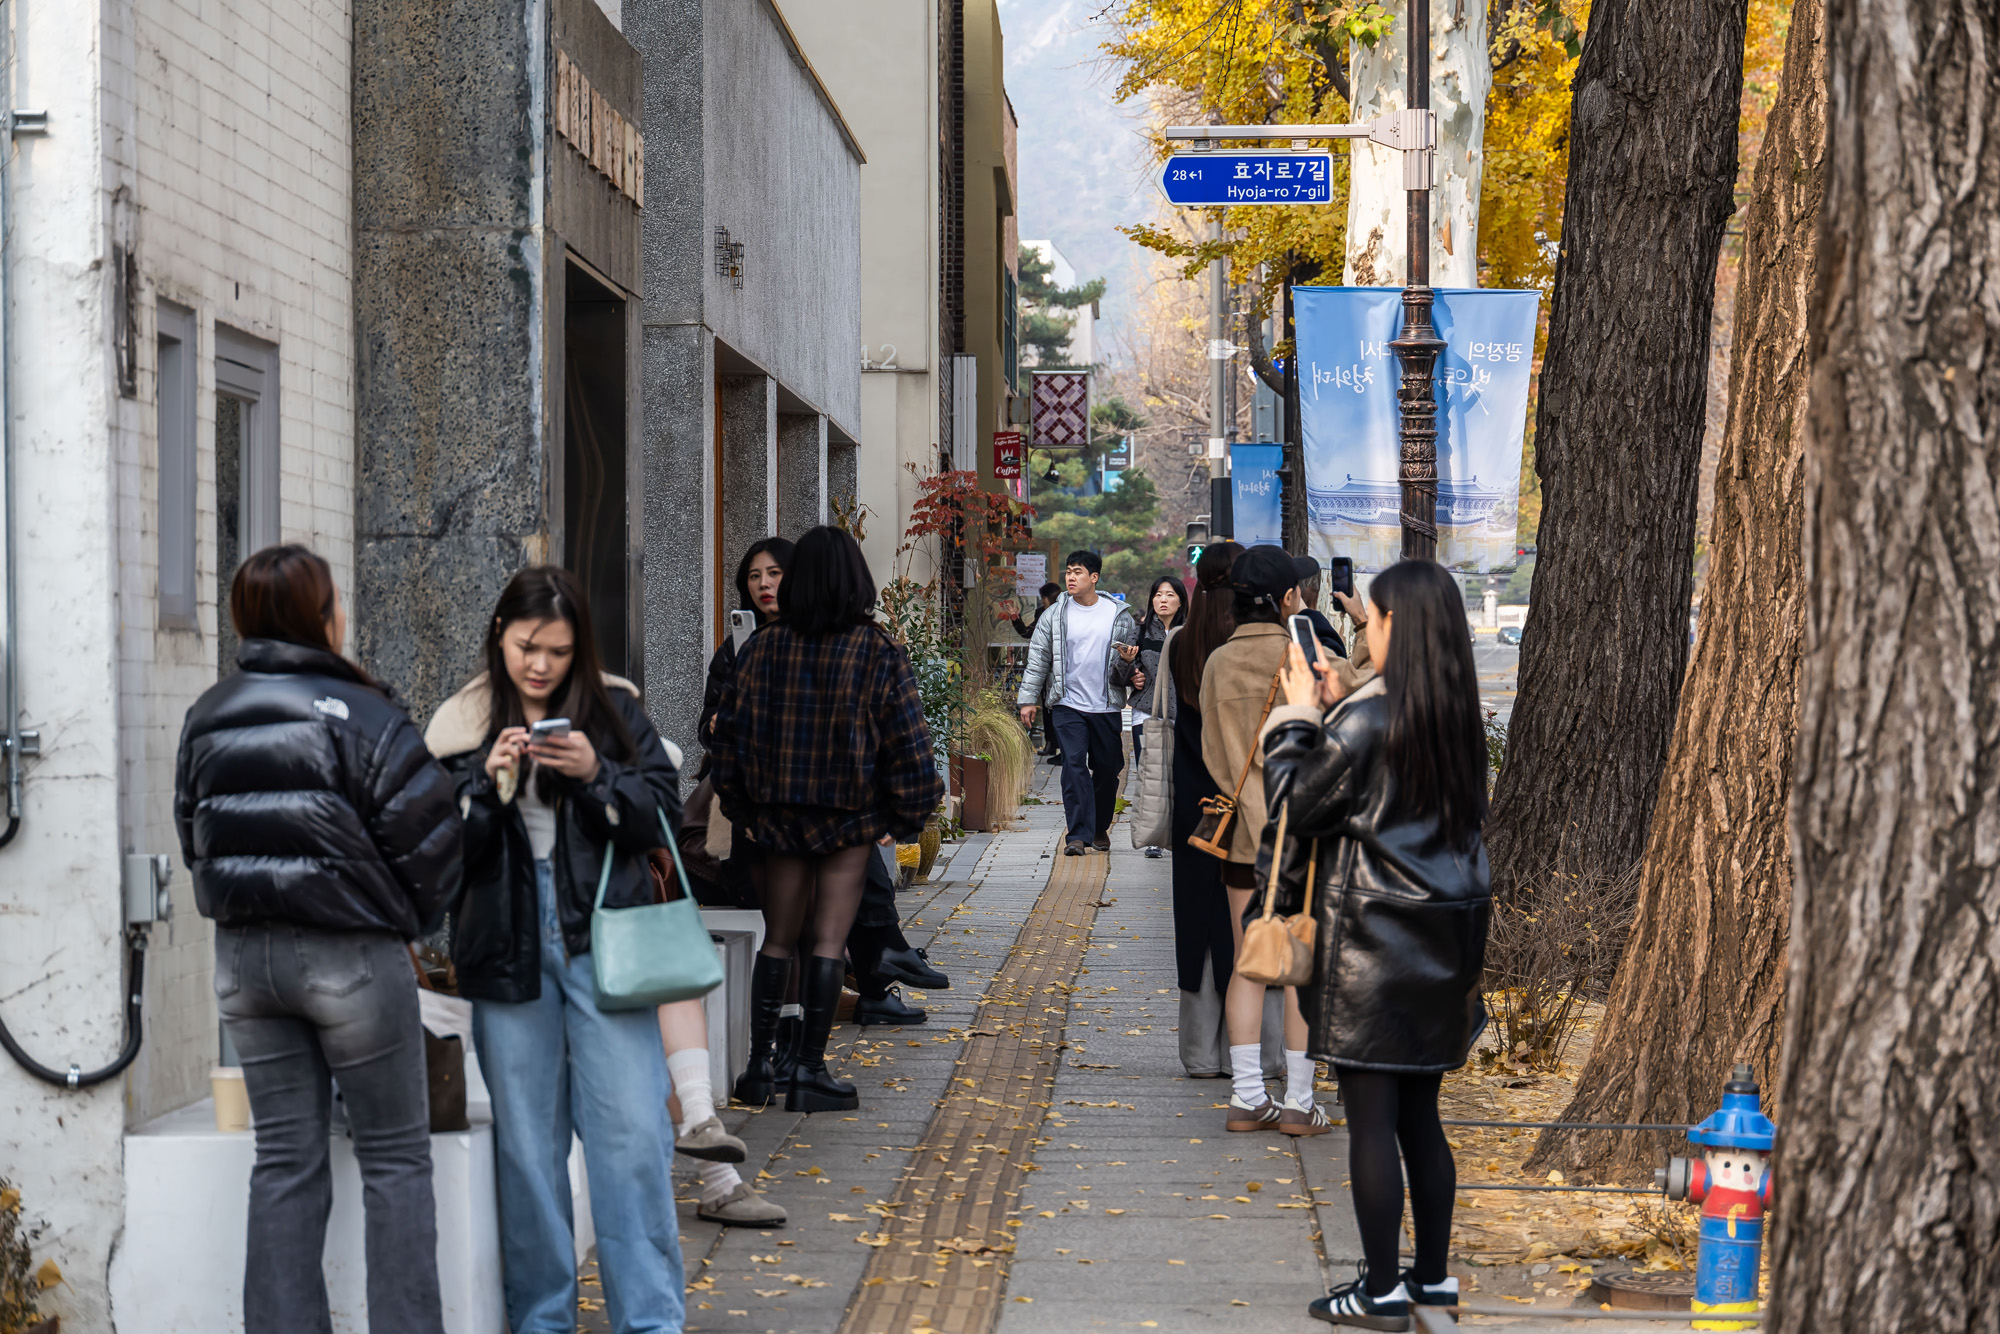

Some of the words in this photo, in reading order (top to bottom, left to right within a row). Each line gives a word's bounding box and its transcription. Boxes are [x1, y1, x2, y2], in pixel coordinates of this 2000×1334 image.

[1233, 160, 1325, 181] 효자로7길
[1227, 185, 1289, 200] Hyoja-ro
[1293, 185, 1325, 200] 7-gil
[995, 466, 1020, 476] Coffee
